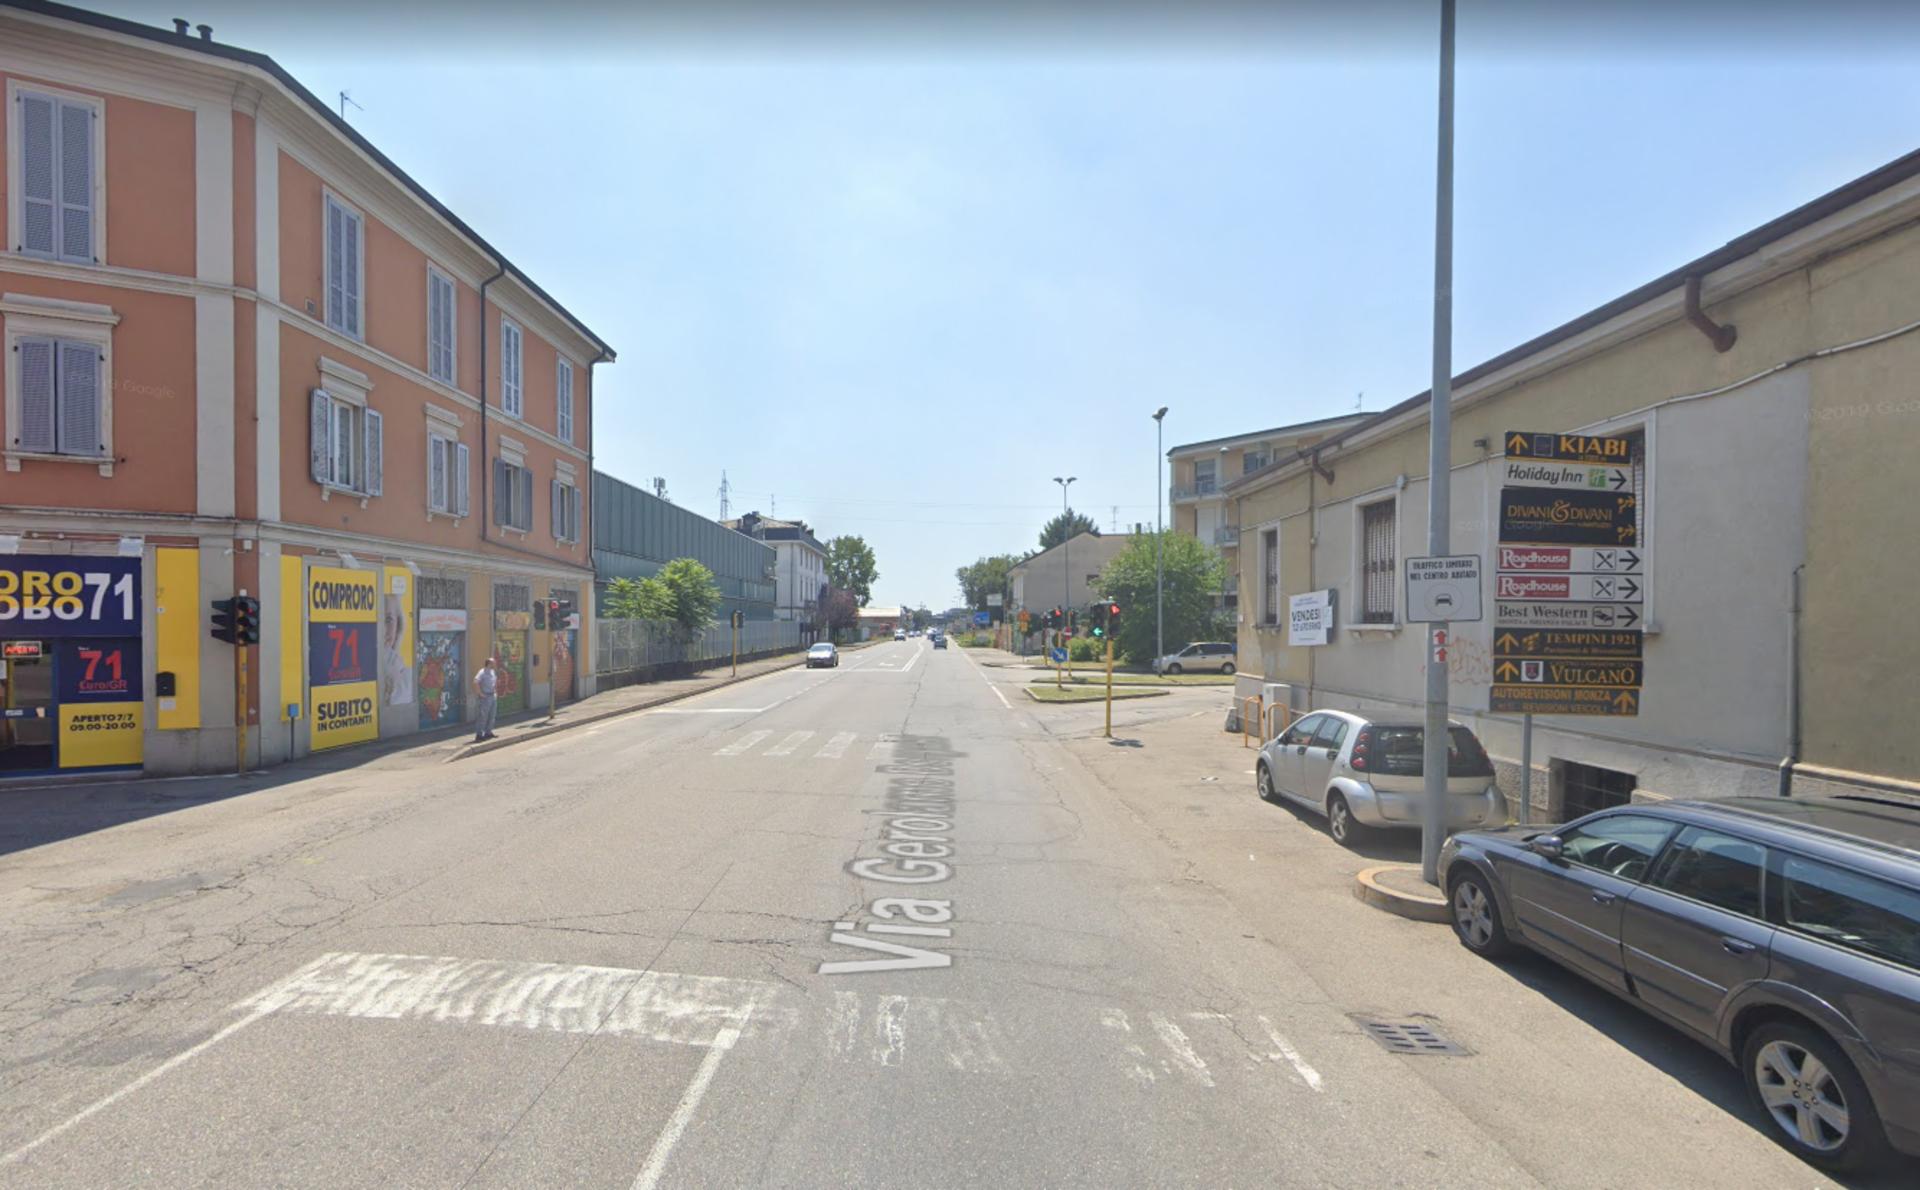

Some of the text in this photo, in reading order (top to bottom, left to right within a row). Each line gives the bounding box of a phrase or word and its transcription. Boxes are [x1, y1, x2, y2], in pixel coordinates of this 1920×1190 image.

[1559, 436, 1627, 456] KIABI
[1508, 464, 1584, 485] Holiday Inn
[1413, 559, 1472, 570] TRAFFICO LIMITATO
[1502, 549, 1568, 568] Roadhouse
[1410, 570, 1477, 580] NEL CENTRO ABITATO
[312, 581, 374, 611] COMPRORO
[1501, 577, 1567, 596] Roadhouse
[84, 573, 133, 620] 71
[1291, 609, 1320, 622] VENDESI
[1498, 604, 1588, 619] Best Western
[328, 629, 358, 668] 71
[1546, 633, 1636, 645] TEMPINI 1921
[79, 650, 121, 681] 71
[1550, 665, 1635, 684] VULCANO
[79, 680, 127, 690] Euro/GR
[1493, 687, 1611, 701] AUTOREVISIONI MONZA
[72, 713, 133, 723] APERTO 7/7
[317, 697, 372, 722] SUBITO
[317, 715, 372, 732] IN CONTANTI
